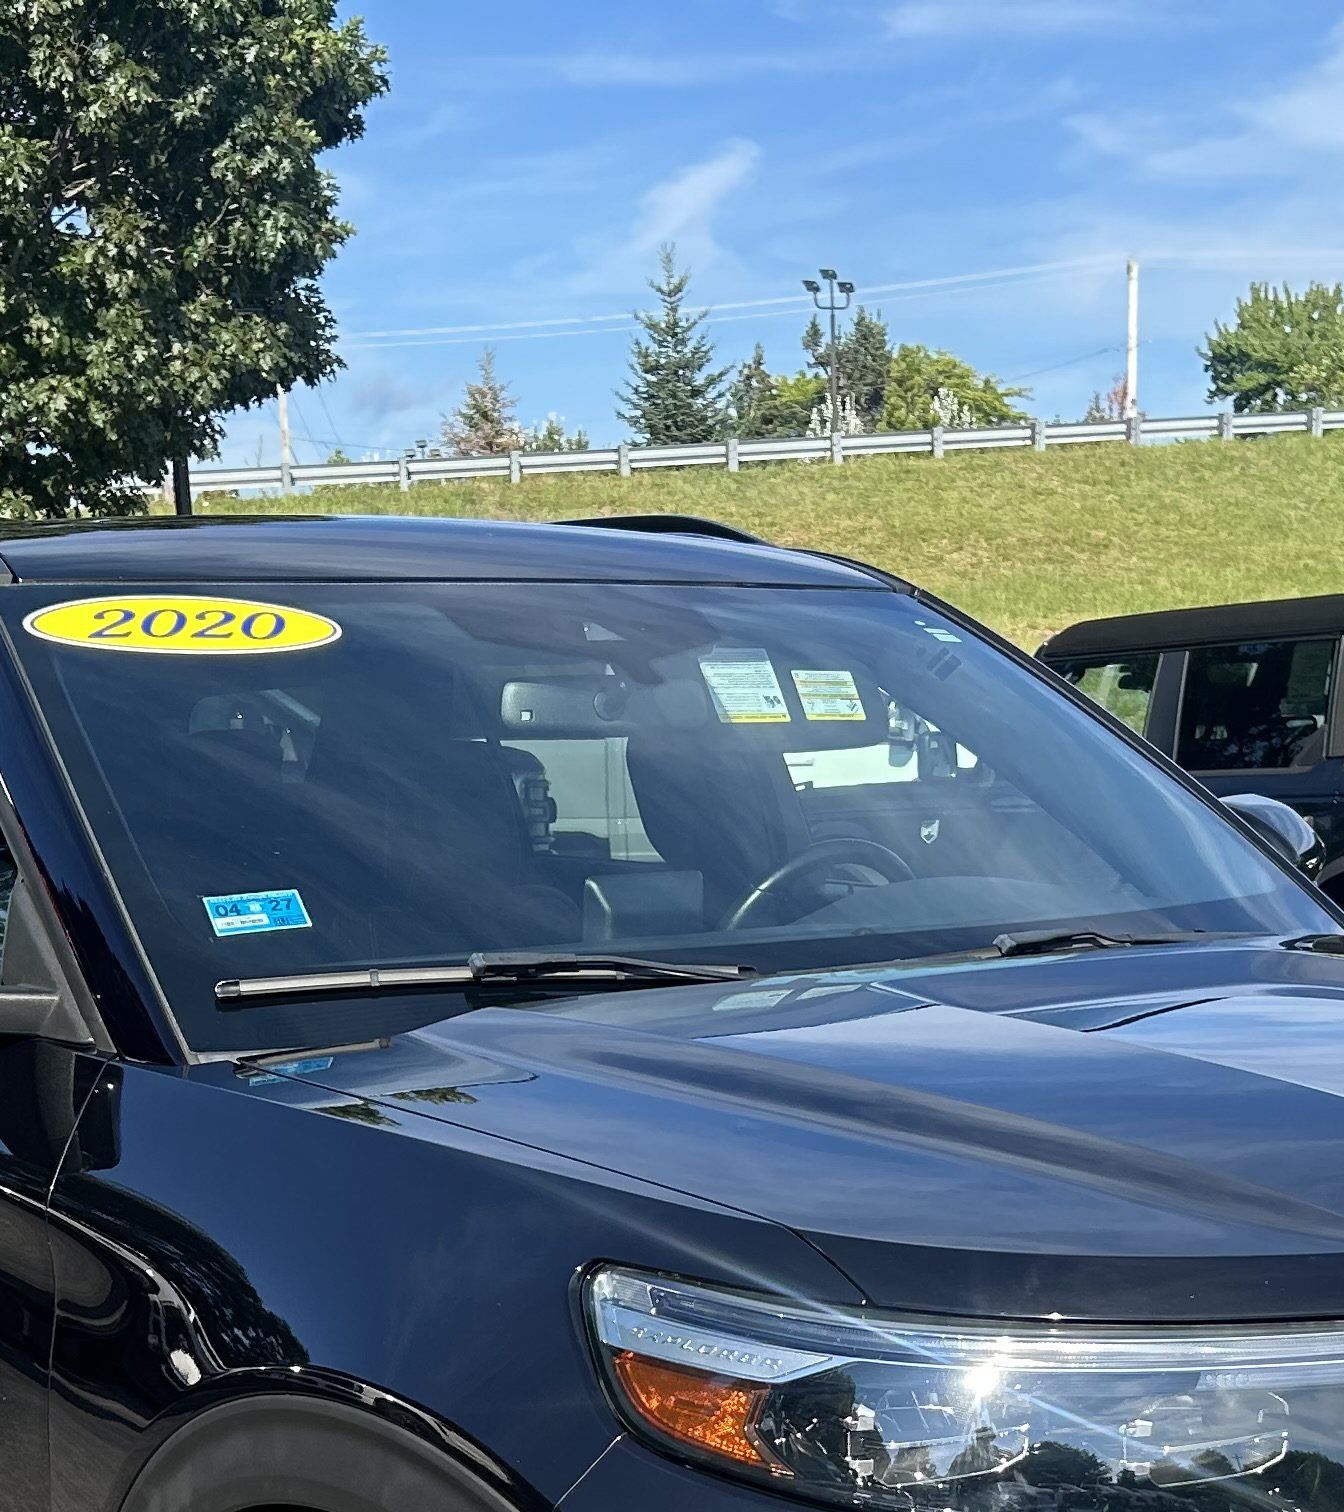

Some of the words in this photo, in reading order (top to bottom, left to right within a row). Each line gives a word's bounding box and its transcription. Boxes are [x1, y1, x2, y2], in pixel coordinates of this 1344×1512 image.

[87, 607, 287, 640] 2020
[215, 904, 241, 917] 04
[268, 898, 292, 911] 27
